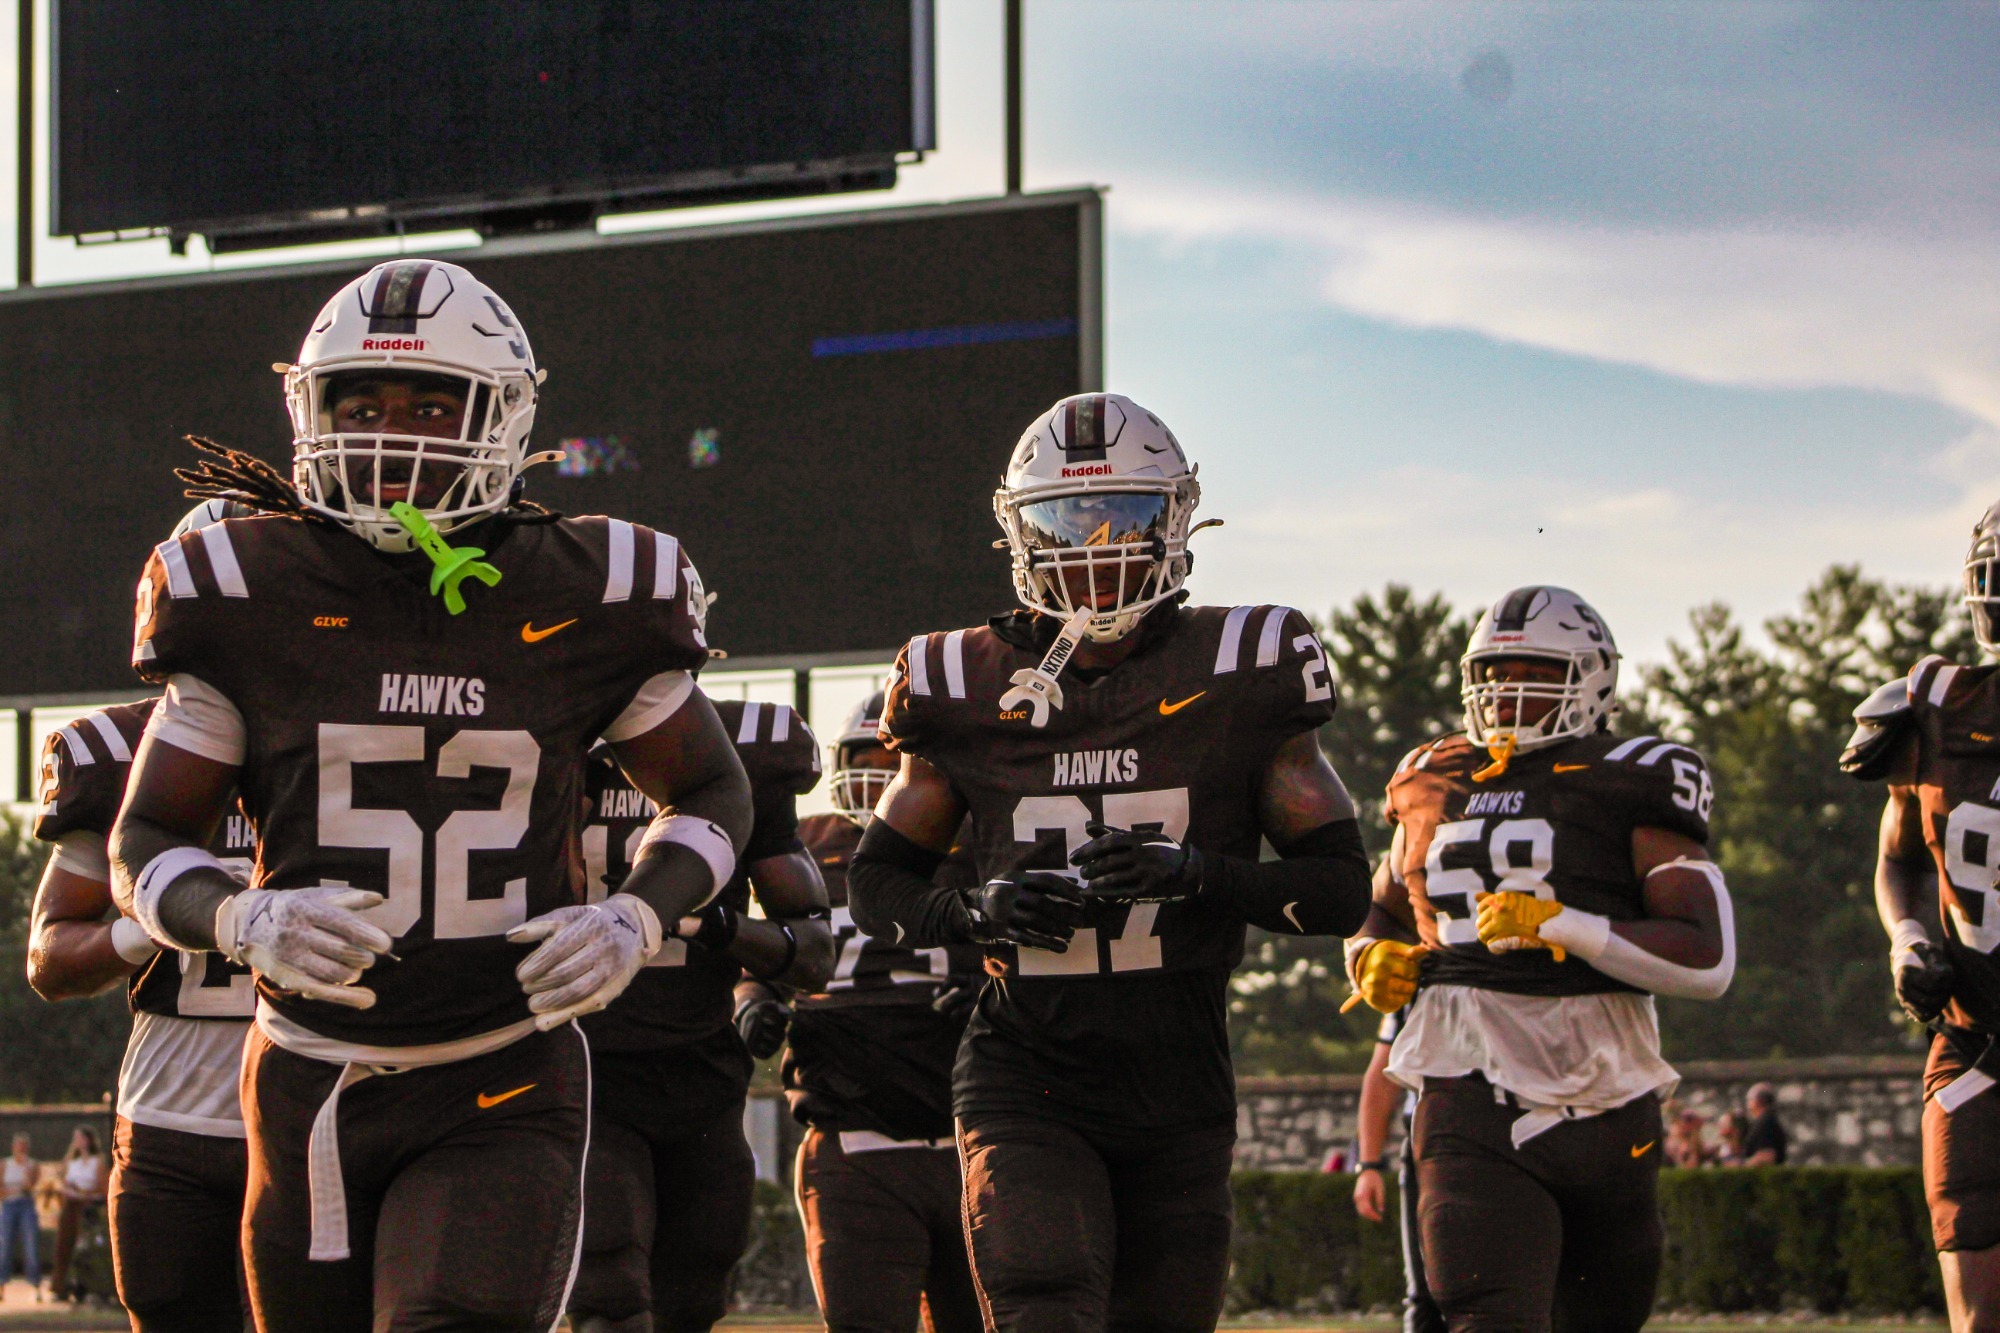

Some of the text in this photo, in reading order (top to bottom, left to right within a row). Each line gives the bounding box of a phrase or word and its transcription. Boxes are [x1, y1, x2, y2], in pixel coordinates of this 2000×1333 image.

[362, 339, 425, 351] Riddell
[1061, 463, 1113, 478] Riddell
[313, 616, 349, 628] GLVC
[1089, 616, 1117, 627] Riddell
[1041, 636, 1074, 677] NXTRND
[378, 673, 486, 716] HAWKS
[999, 710, 1028, 720] GLVC
[1053, 748, 1139, 787] HAWKS
[1464, 790, 1525, 815] HAWKS
[1671, 758, 1714, 823] 58
[318, 722, 542, 940] 52
[1012, 787, 1190, 976] 27
[1424, 818, 1556, 947] 58
